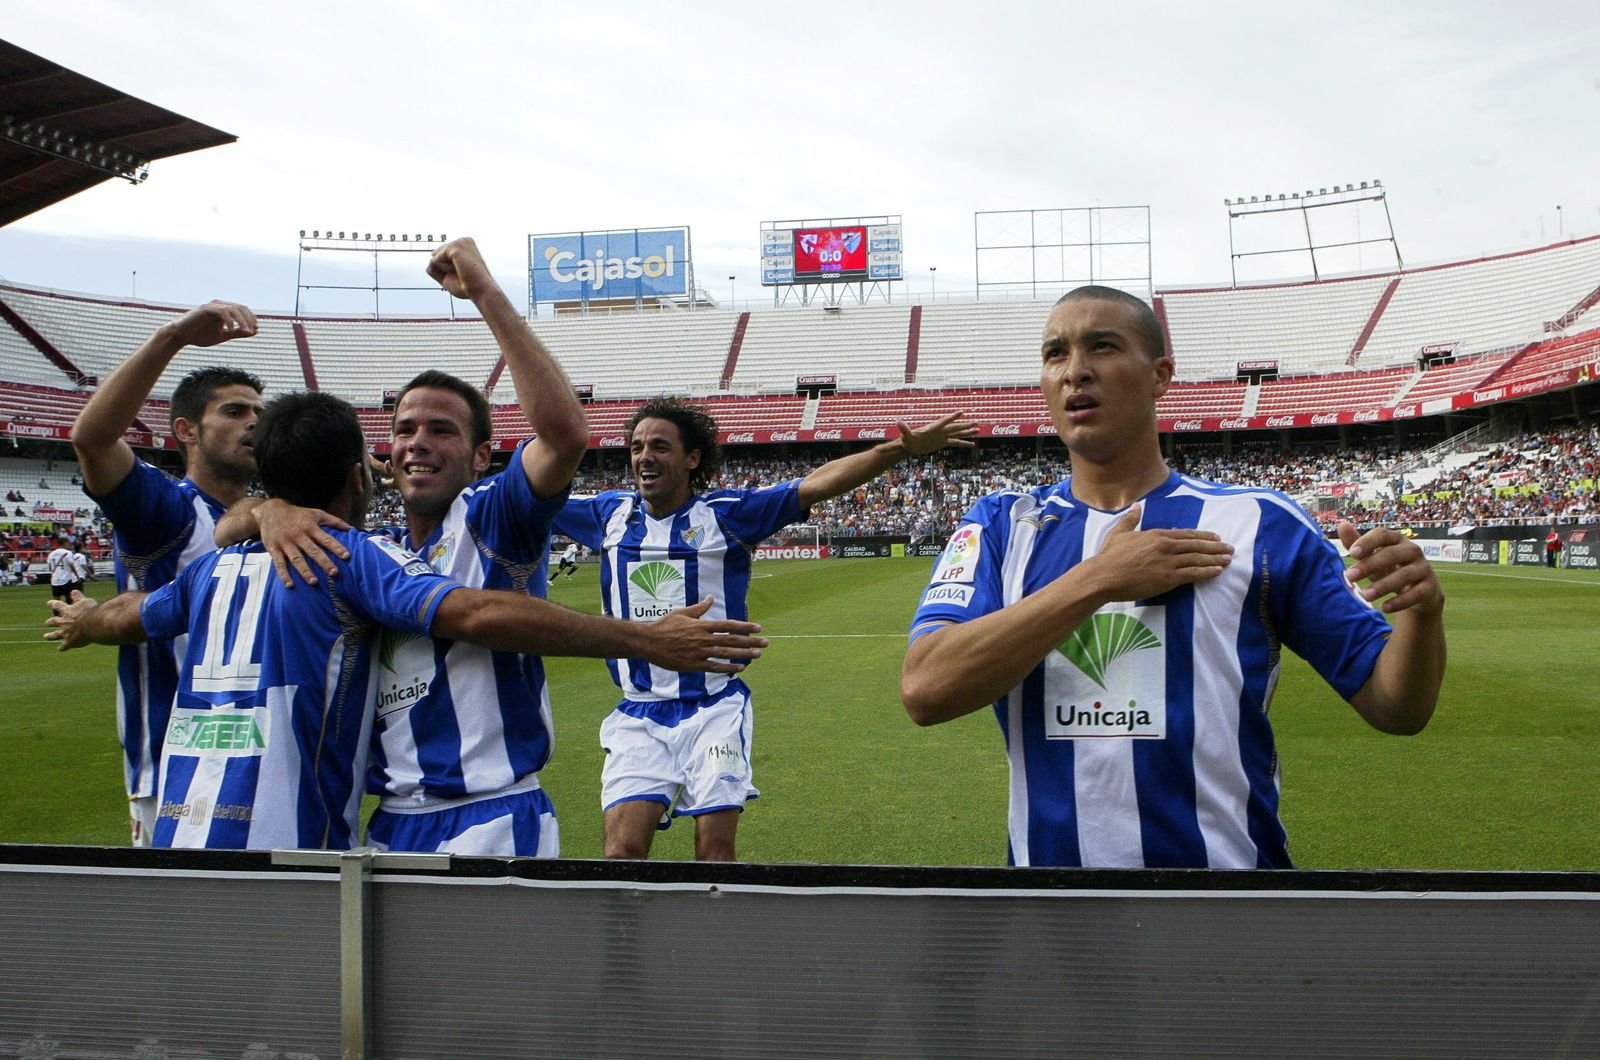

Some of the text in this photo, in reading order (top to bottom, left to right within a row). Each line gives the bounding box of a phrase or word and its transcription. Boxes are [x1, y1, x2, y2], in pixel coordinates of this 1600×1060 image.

[819, 250, 842, 262] 0:0
[549, 245, 674, 289] Cajasol
[1173, 419, 1202, 430] Coca-Cola
[1219, 417, 1248, 429] Coca-Cola
[1266, 415, 1295, 427] Coca-Cola
[1311, 413, 1338, 425] Coca-Cola
[7, 422, 54, 437] Cruzcampo
[770, 430, 798, 441] Coca-Cola
[814, 429, 841, 440] Coca-Cola
[858, 428, 887, 439] Coca-Cola
[600, 436, 625, 447] Coca-Cola
[727, 432, 755, 442] Coca-Cola
[755, 545, 822, 560] eurotex
[941, 566, 964, 580] LFP
[928, 588, 966, 602] BBVA
[634, 603, 673, 618] Unica
[192, 552, 272, 692] 11
[377, 677, 428, 709] Unicaja
[1056, 700, 1151, 731] Unicaja
